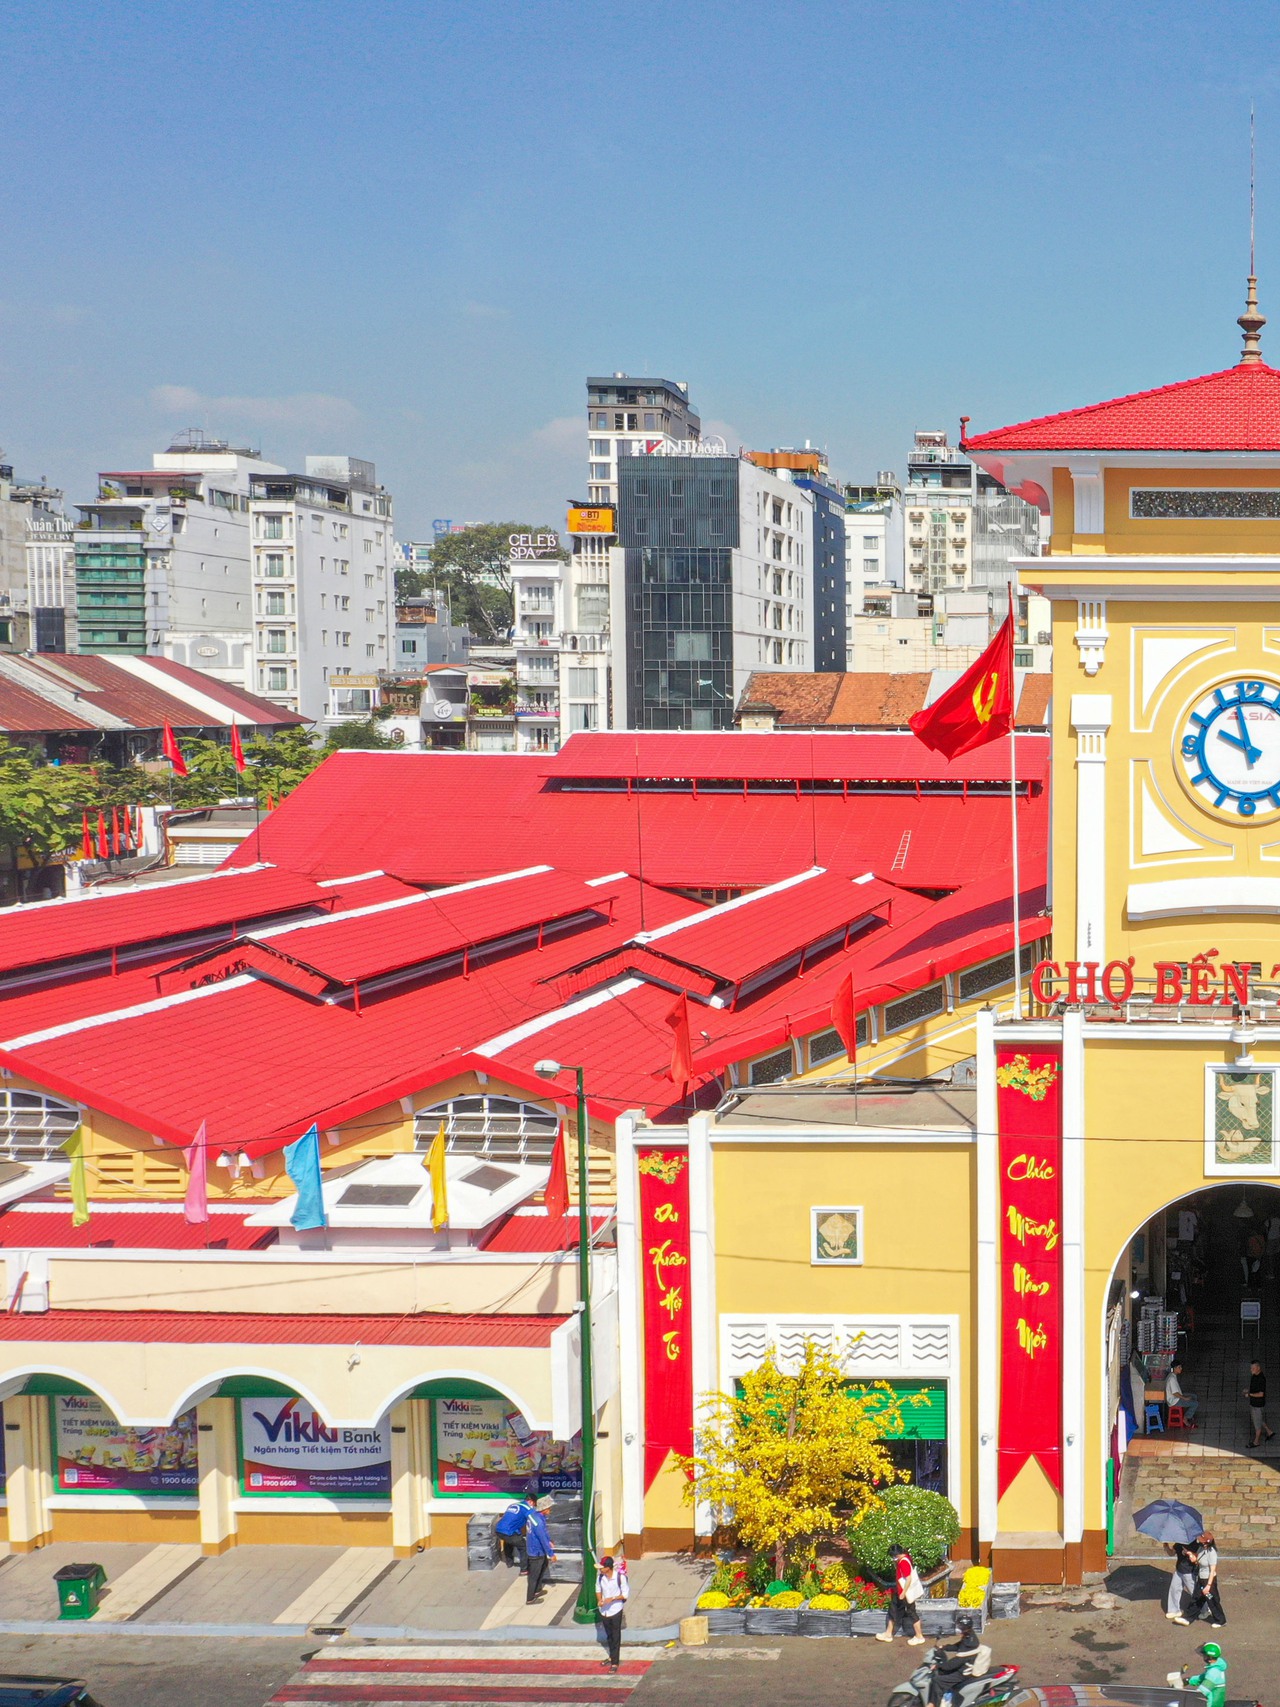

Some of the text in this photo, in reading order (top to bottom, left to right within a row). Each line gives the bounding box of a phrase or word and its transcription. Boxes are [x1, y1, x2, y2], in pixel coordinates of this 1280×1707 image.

[509, 547, 536, 559] SPA
[1236, 681, 1265, 701] 12
[1182, 735, 1201, 755] 9
[1238, 794, 1256, 815] 6
[1031, 956, 1136, 1010] CHỢ
[1153, 948, 1251, 1005] BẾN
[1007, 1153, 1055, 1181] Chúc
[649, 1239, 687, 1291] Xuân
[660, 1286, 682, 1320] Hội
[1016, 1318, 1047, 1360] Mới
[443, 1399, 469, 1411] Vikki
[253, 1397, 338, 1442] Vikki
[443, 1421, 459, 1429] TIẾT
[461, 1421, 479, 1431] KIỆM
[343, 1431, 381, 1443] Bank
[443, 1430, 463, 1438] Trúng
[253, 1445, 382, 1455] Ngân hàng Tiết kiệm Tốt nhất!
[562, 1480, 582, 1488] 6608
